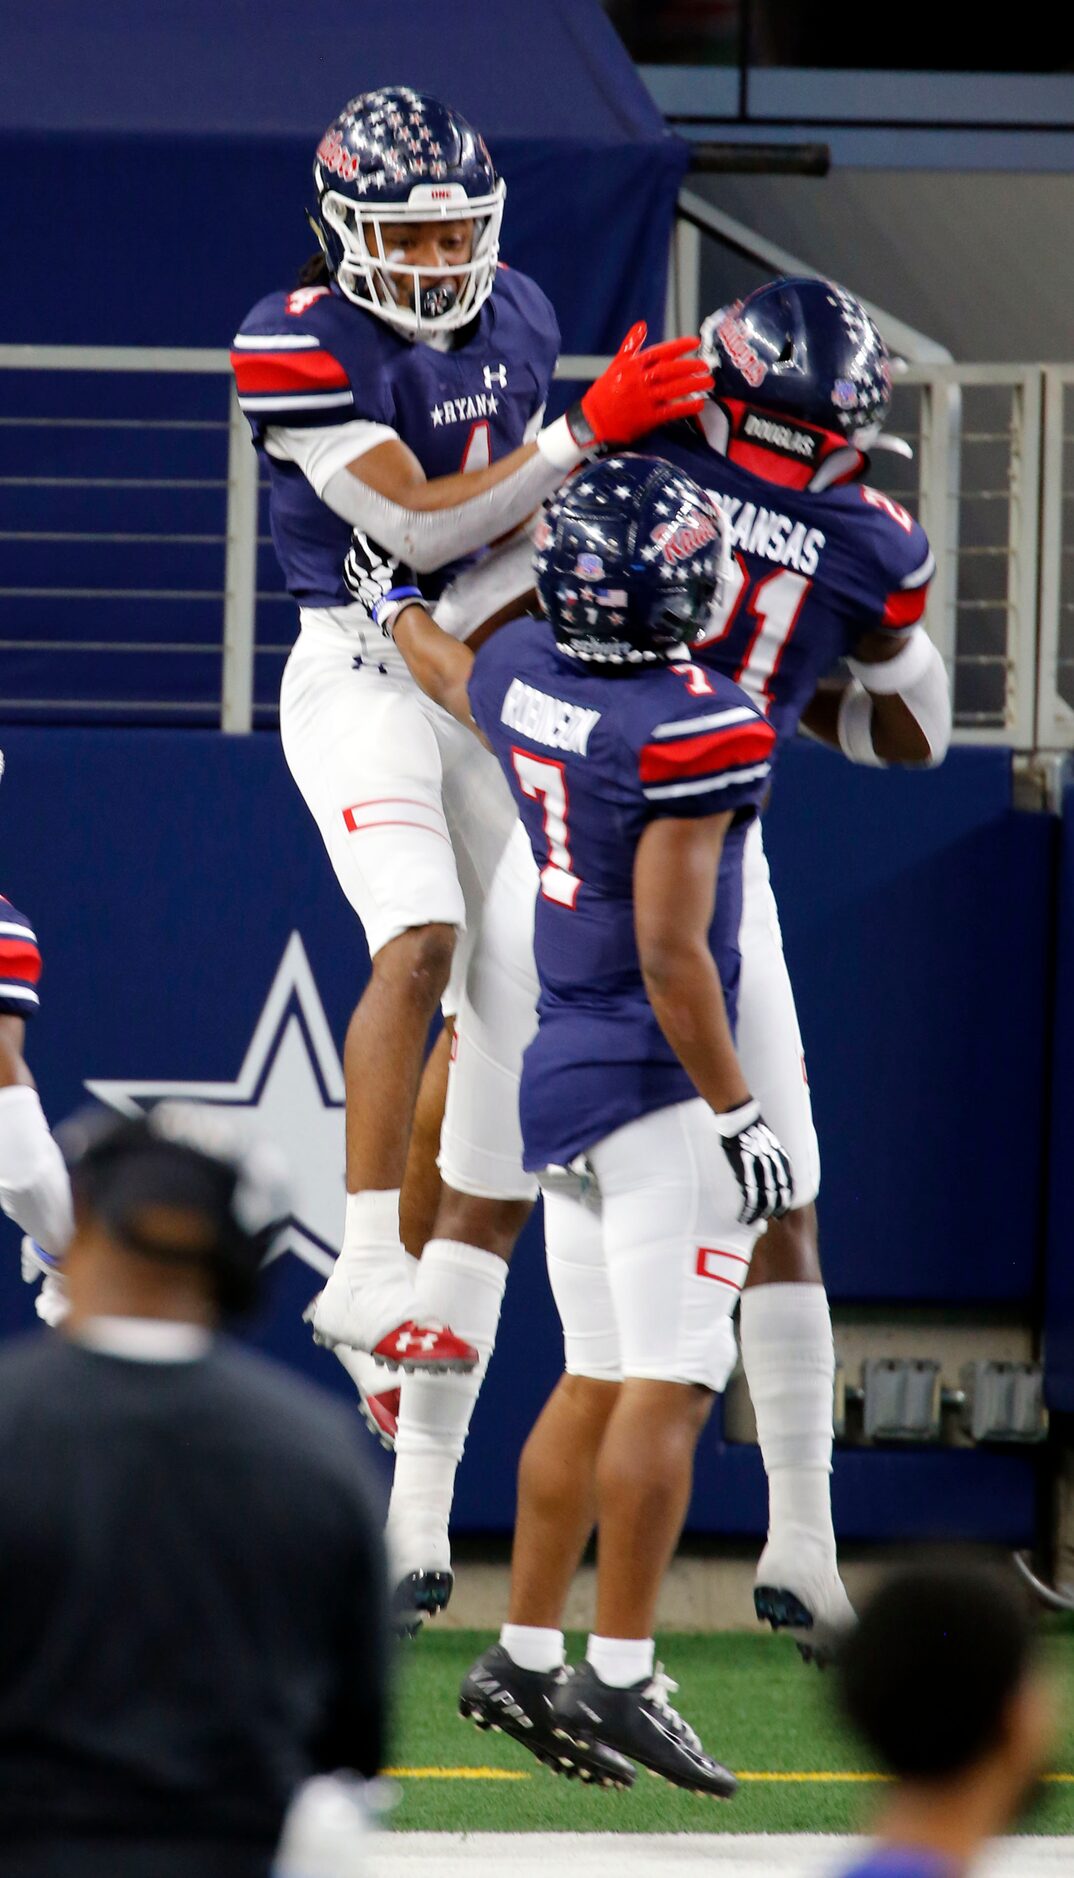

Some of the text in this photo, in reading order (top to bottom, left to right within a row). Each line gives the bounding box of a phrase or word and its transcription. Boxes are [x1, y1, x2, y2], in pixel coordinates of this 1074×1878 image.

[443, 394, 487, 424] RYAN
[669, 663, 716, 697] 7
[511, 744, 583, 912] 7
